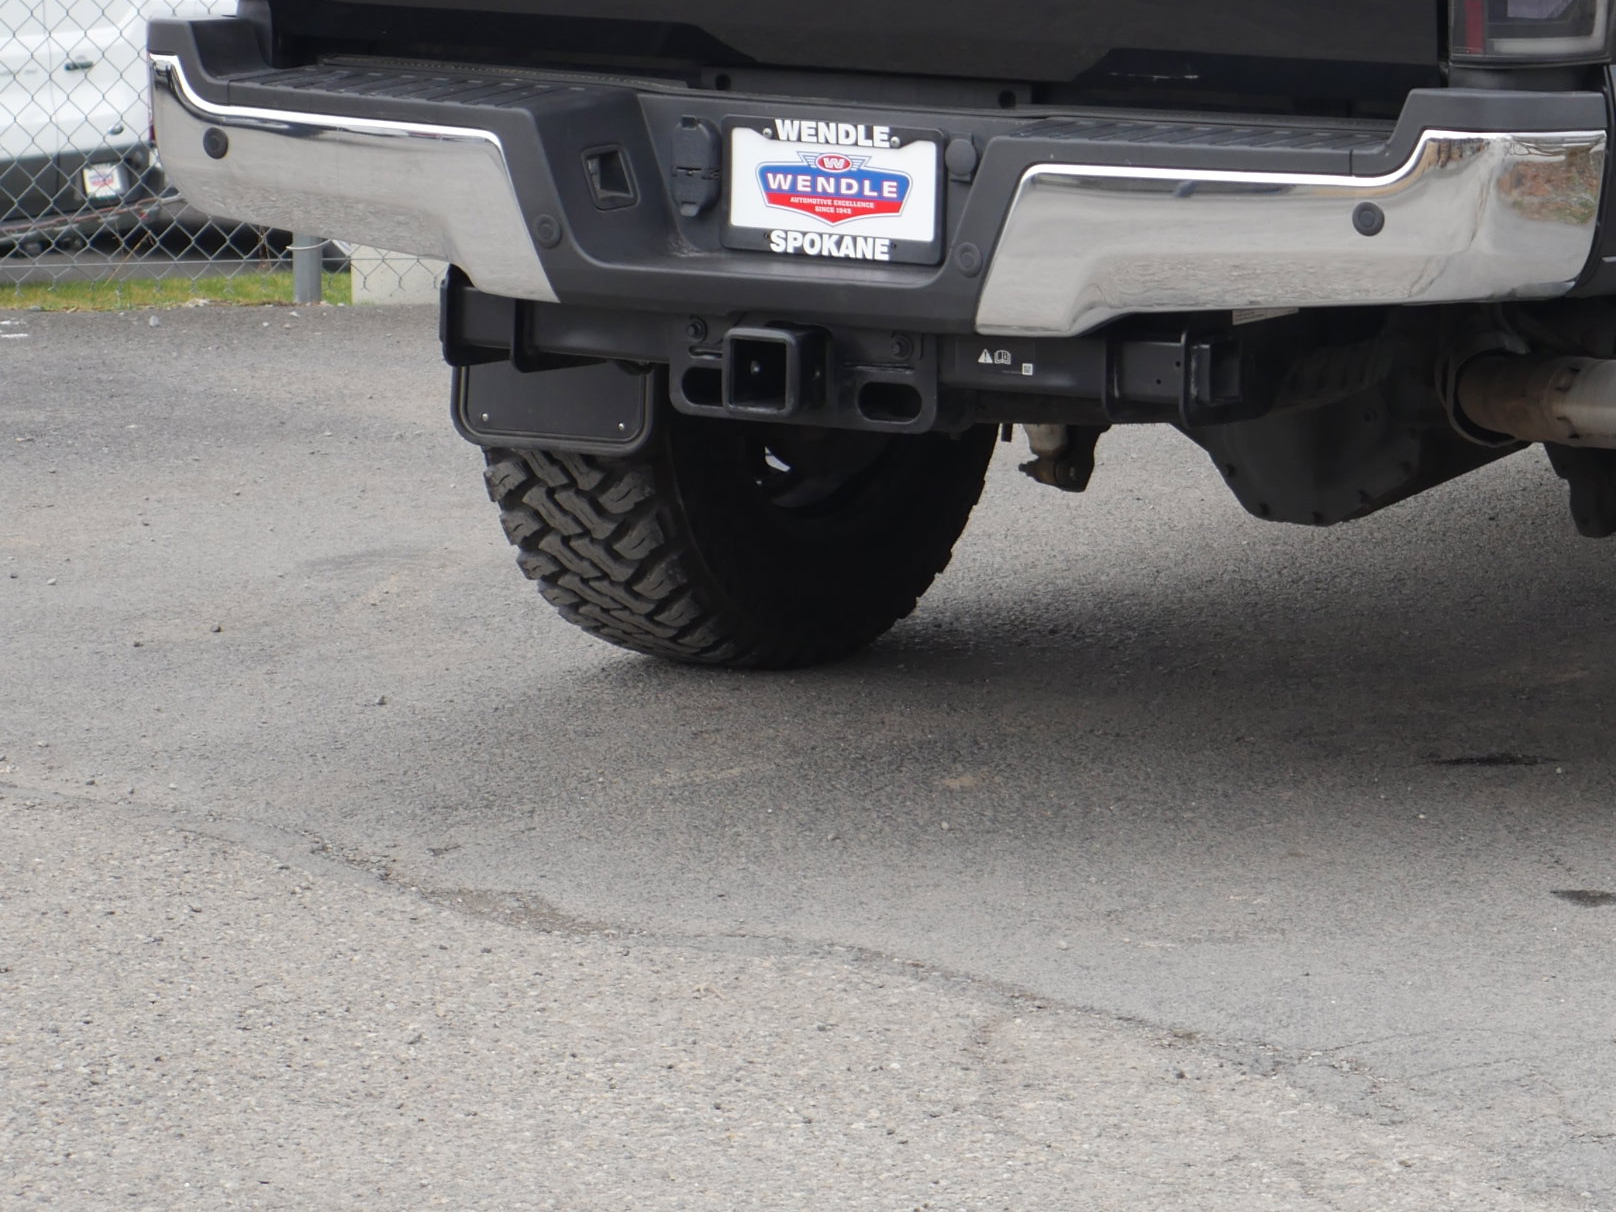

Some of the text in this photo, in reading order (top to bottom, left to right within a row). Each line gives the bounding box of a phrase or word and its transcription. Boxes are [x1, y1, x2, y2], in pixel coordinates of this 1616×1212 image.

[775, 119, 890, 148] WENDLE
[767, 172, 898, 198] WENDLE
[790, 196, 875, 209] AUTOMOTIVE EXCELLENCE
[815, 205, 834, 213] SINCE
[770, 229, 890, 260] SPOKANE
